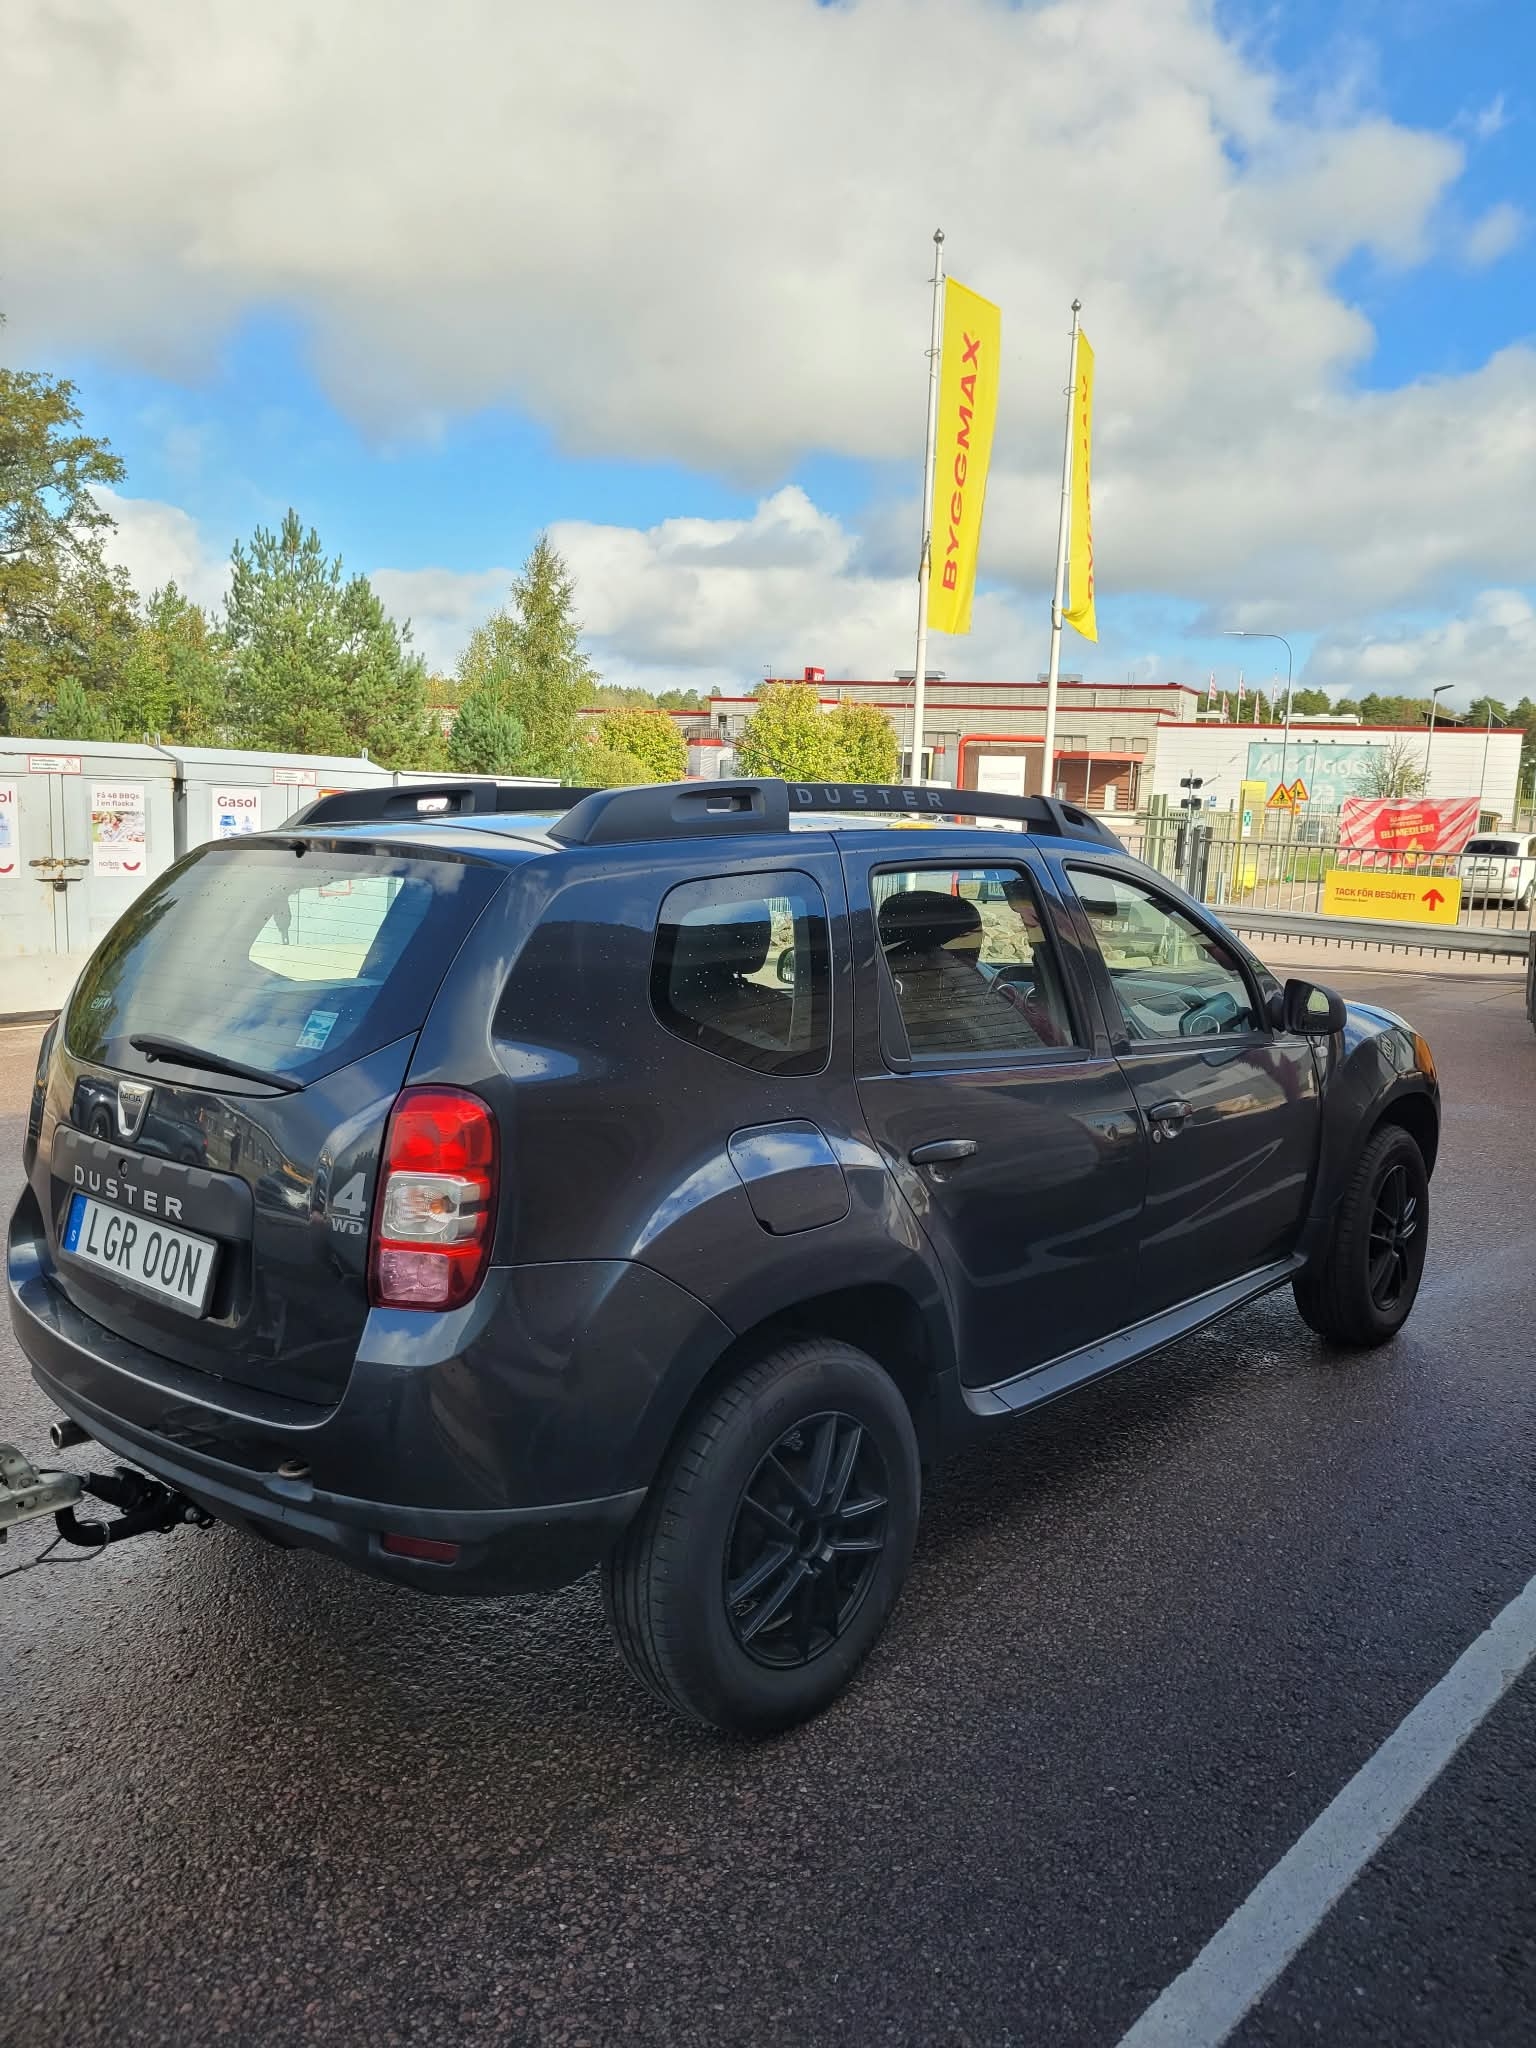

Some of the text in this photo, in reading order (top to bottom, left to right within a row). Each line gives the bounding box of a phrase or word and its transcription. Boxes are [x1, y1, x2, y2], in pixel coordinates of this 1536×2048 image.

[942, 331, 982, 590] BYGGMAX
[217, 796, 257, 808] Gasol
[795, 788, 944, 807] DUSTER
[1335, 887, 1356, 896] TACK
[1357, 887, 1373, 898] FÖR
[1375, 889, 1416, 901] BESÖKET!
[74, 1164, 183, 1220] DUSTER
[333, 1172, 367, 1216] 4
[331, 1217, 364, 1235] WD
[70, 1230, 77, 1242] S
[86, 1207, 138, 1270] LGR
